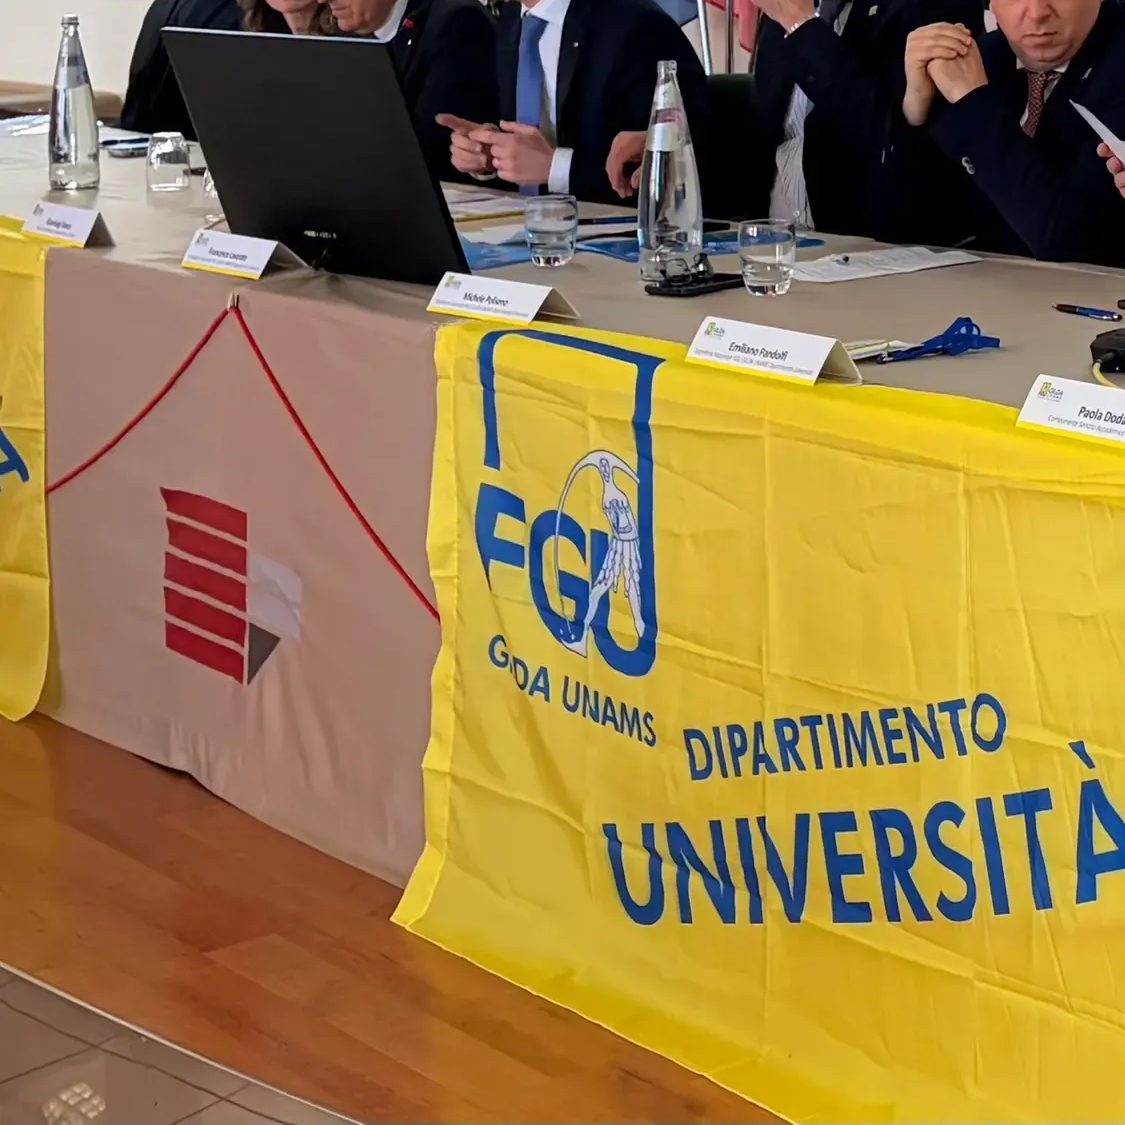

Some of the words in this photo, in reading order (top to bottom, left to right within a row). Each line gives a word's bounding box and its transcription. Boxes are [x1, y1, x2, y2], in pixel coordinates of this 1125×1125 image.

[1078, 406, 1103, 421] Paola
[475, 481, 658, 677] FGU
[488, 634, 551, 704] GDA
[562, 676, 657, 748] UNAMS
[682, 692, 1007, 781] DIPARTIMENTO
